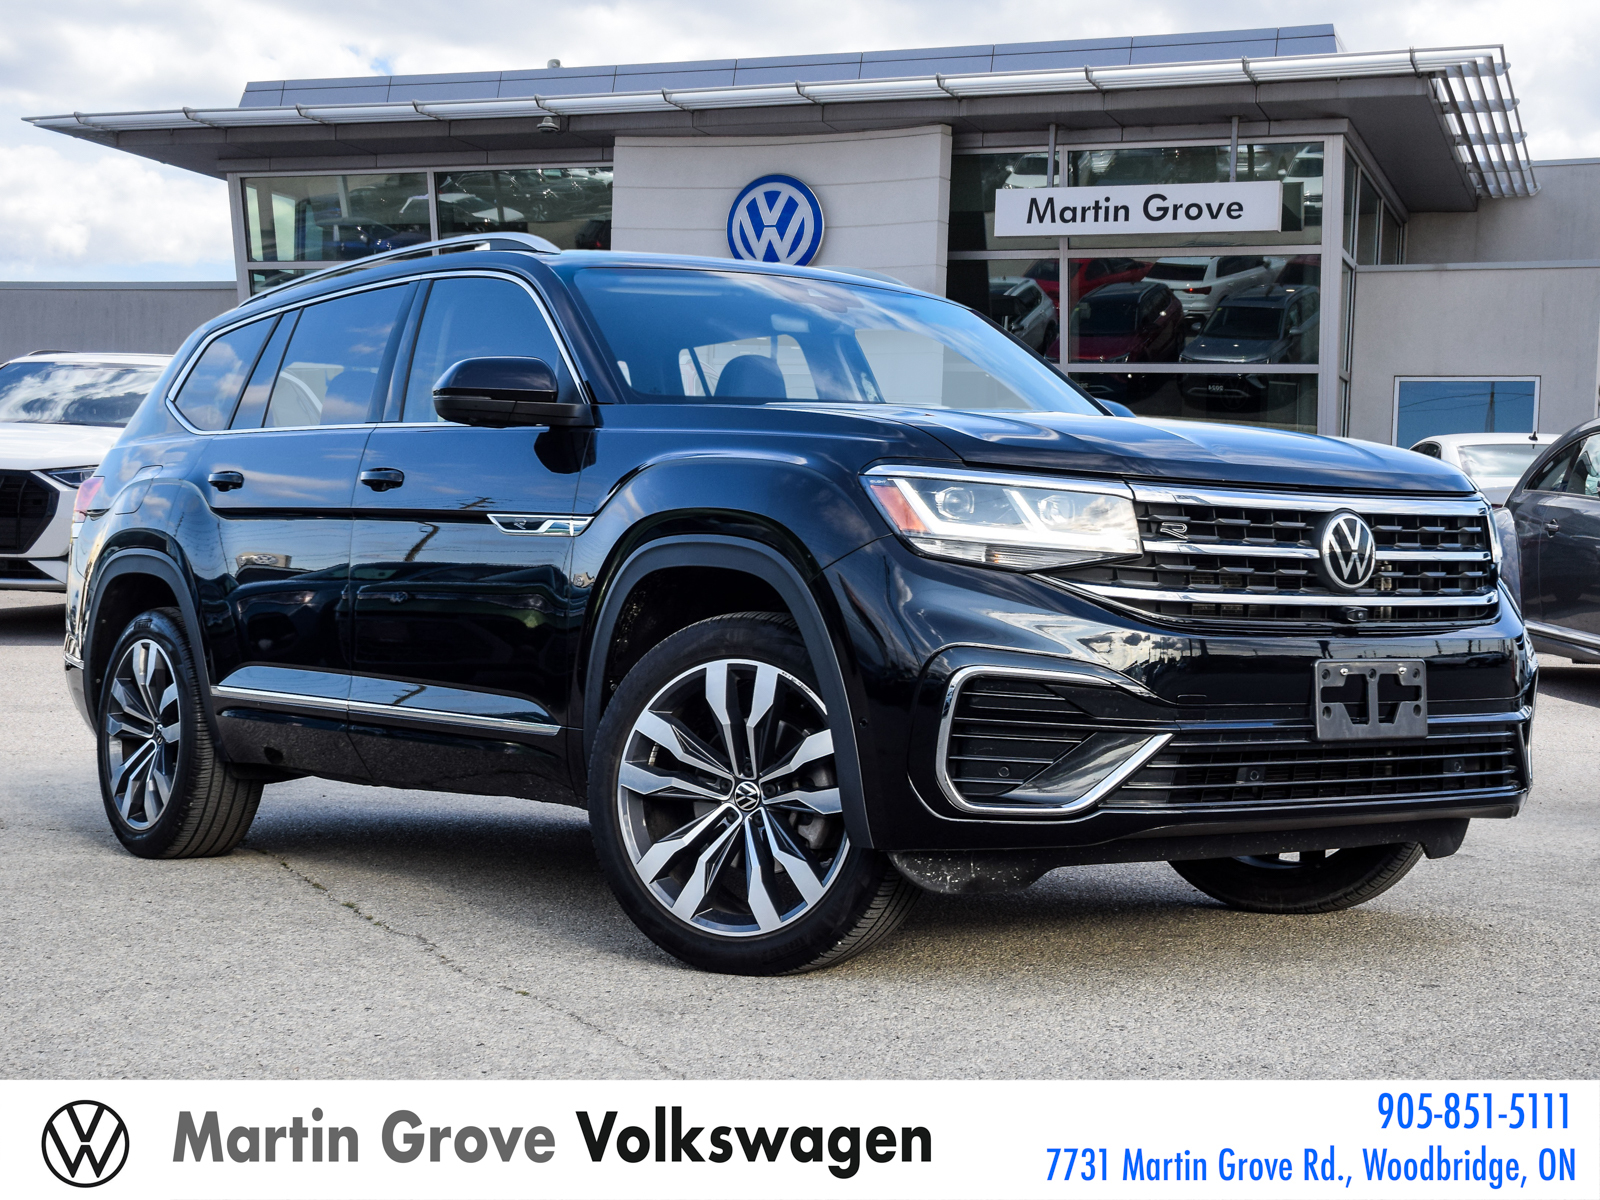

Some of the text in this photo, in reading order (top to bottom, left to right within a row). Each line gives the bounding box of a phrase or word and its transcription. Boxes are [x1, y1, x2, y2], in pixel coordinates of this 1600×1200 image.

[1026, 193, 1245, 224] Martin Grove
[1322, 511, 1376, 589] VW
